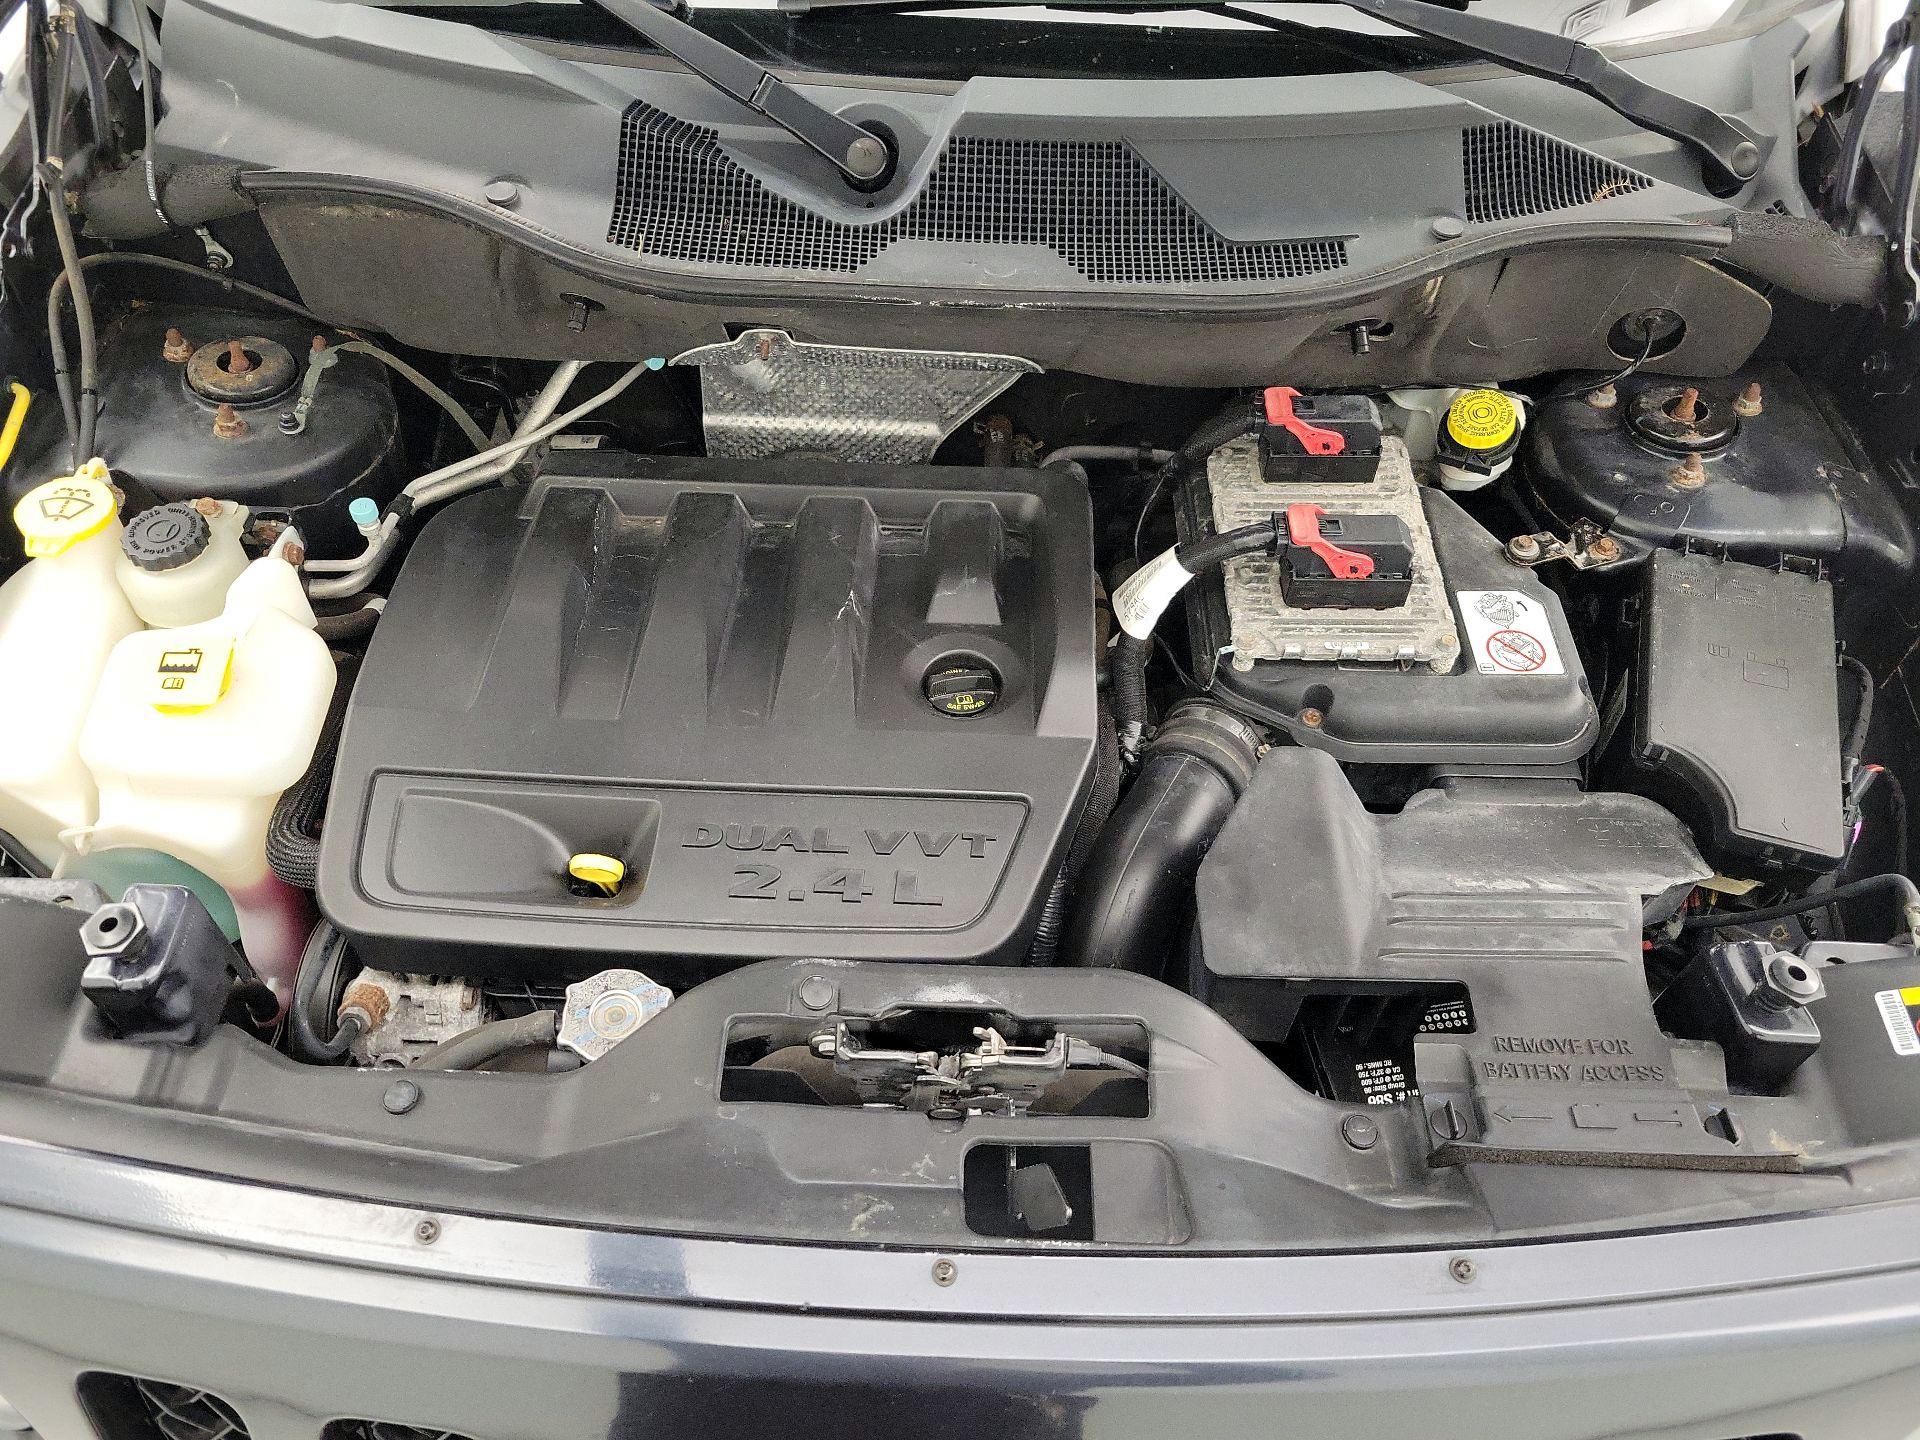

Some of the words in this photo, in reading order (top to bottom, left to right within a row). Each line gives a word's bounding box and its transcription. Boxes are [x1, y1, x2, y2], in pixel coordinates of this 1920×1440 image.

[681, 823, 849, 854] DUAL
[864, 829, 998, 858] VVT
[1494, 1036, 1580, 1055] REMOVE
[1586, 1038, 1633, 1055] FOR
[1483, 1062, 1571, 1081] BATTERY
[1581, 1064, 1665, 1082] ACCESS
